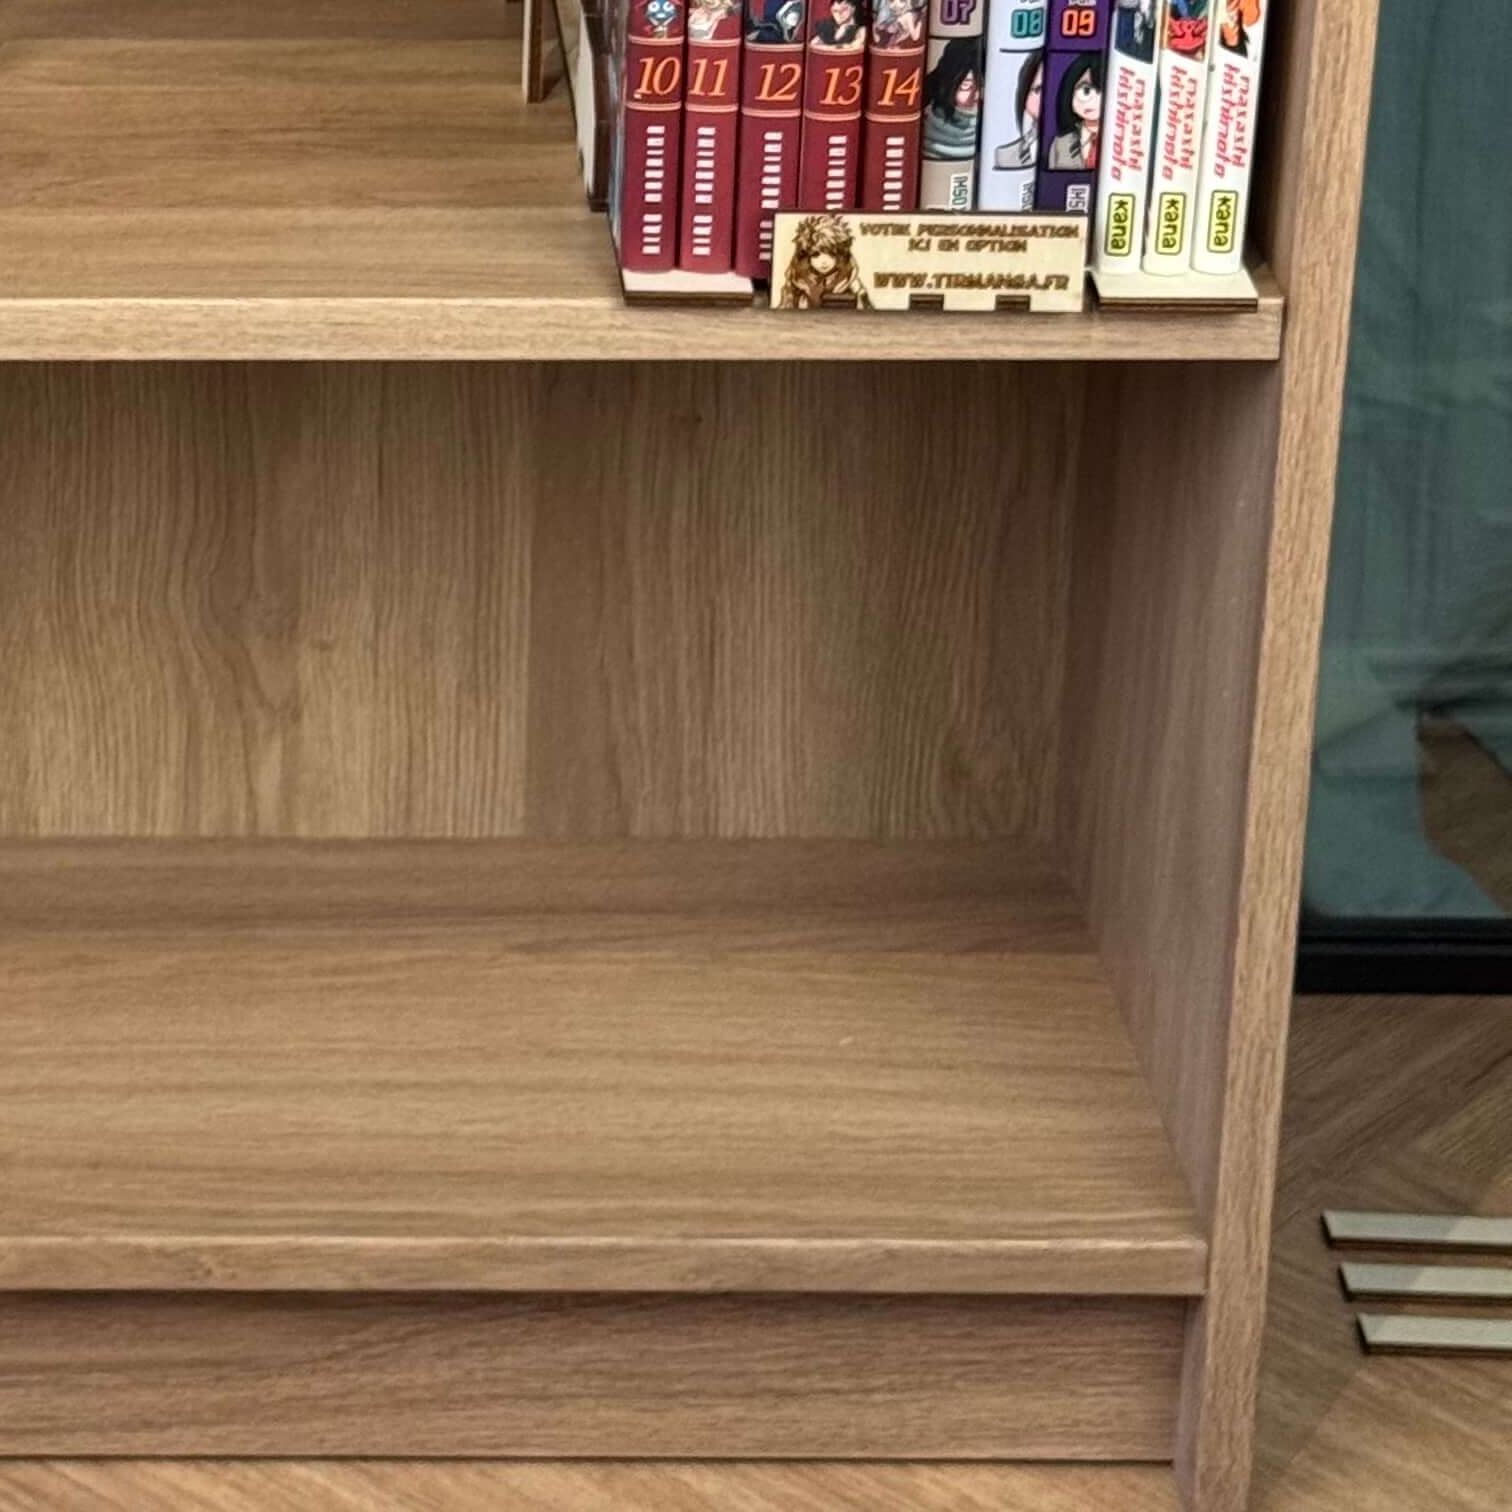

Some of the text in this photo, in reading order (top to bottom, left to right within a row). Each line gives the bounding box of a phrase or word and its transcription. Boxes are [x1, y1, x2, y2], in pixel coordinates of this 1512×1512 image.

[1011, 8, 1044, 38] 08
[1062, 9, 1096, 36] 09
[638, 57, 681, 95] 10
[689, 59, 728, 96] 11
[755, 63, 801, 101] 12
[820, 66, 864, 105] 13
[878, 68, 921, 106] 14
[1111, 199, 1128, 251] kana
[1163, 197, 1179, 250] kana
[1214, 196, 1231, 247] kana
[966, 240, 1027, 252] OPTION
